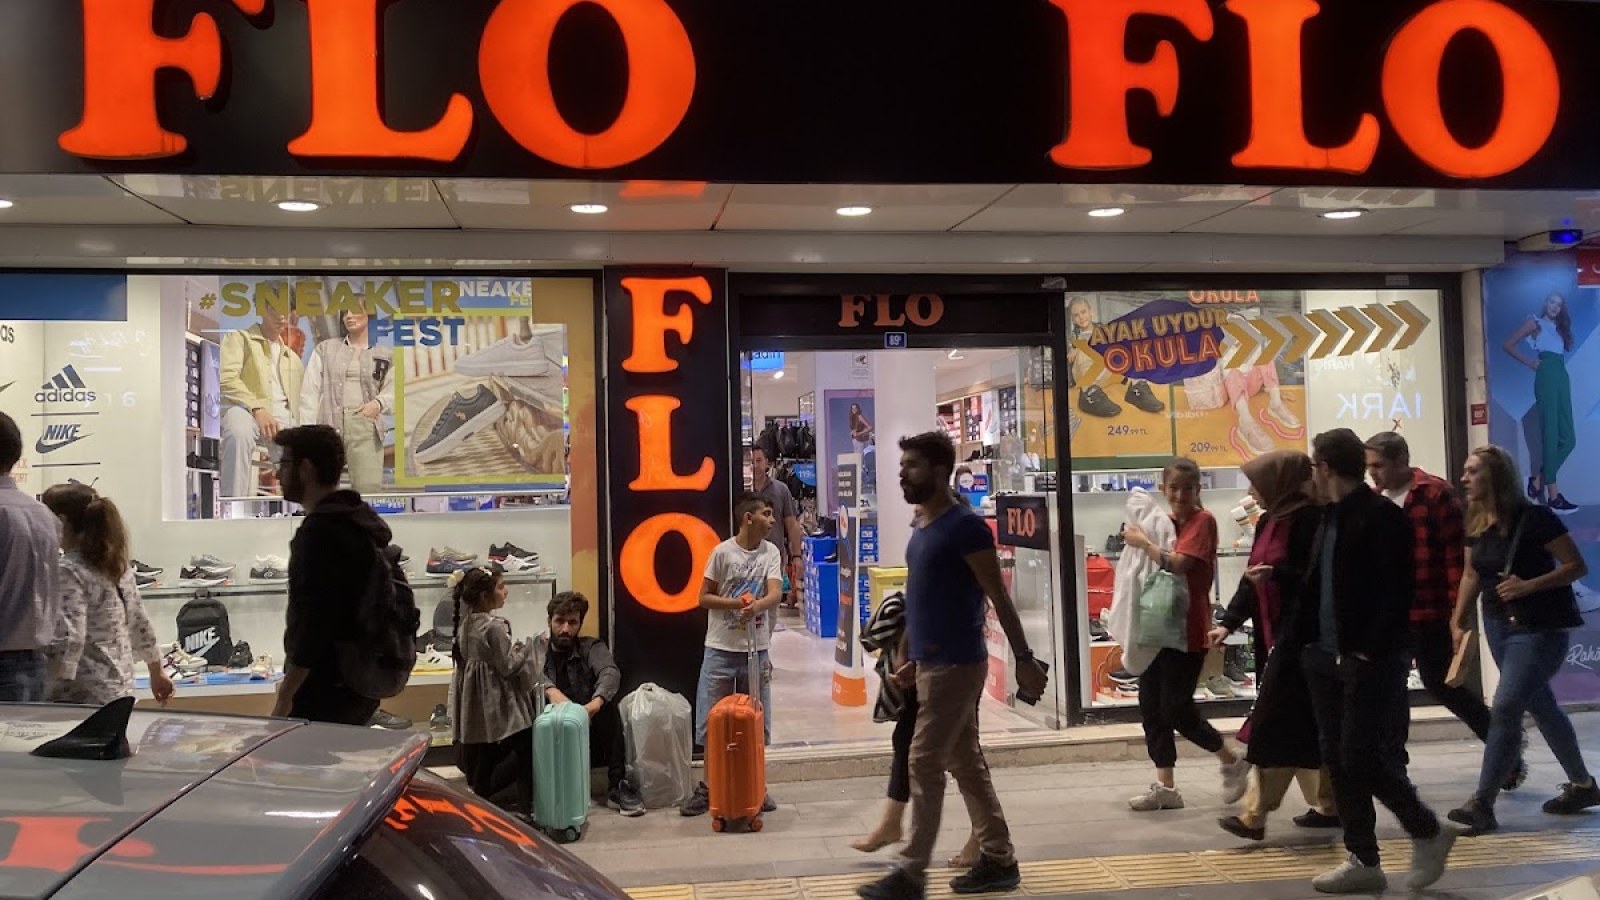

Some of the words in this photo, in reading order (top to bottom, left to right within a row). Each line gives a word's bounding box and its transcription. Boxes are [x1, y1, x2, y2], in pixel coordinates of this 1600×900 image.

[58, 0, 696, 169] FLO
[1047, 0, 1560, 178] FLO
[440, 281, 532, 297] NEAKE
[838, 293, 945, 327] FLO
[368, 318, 465, 346] FEST
[1089, 318, 1149, 346] AYAK
[1151, 308, 1229, 338] UYDUR
[1104, 331, 1222, 375] OKULA
[34, 388, 97, 403] adidas
[43, 424, 82, 440] NIKE
[1006, 507, 1036, 537] FLO
[184, 626, 217, 652] NIKE
